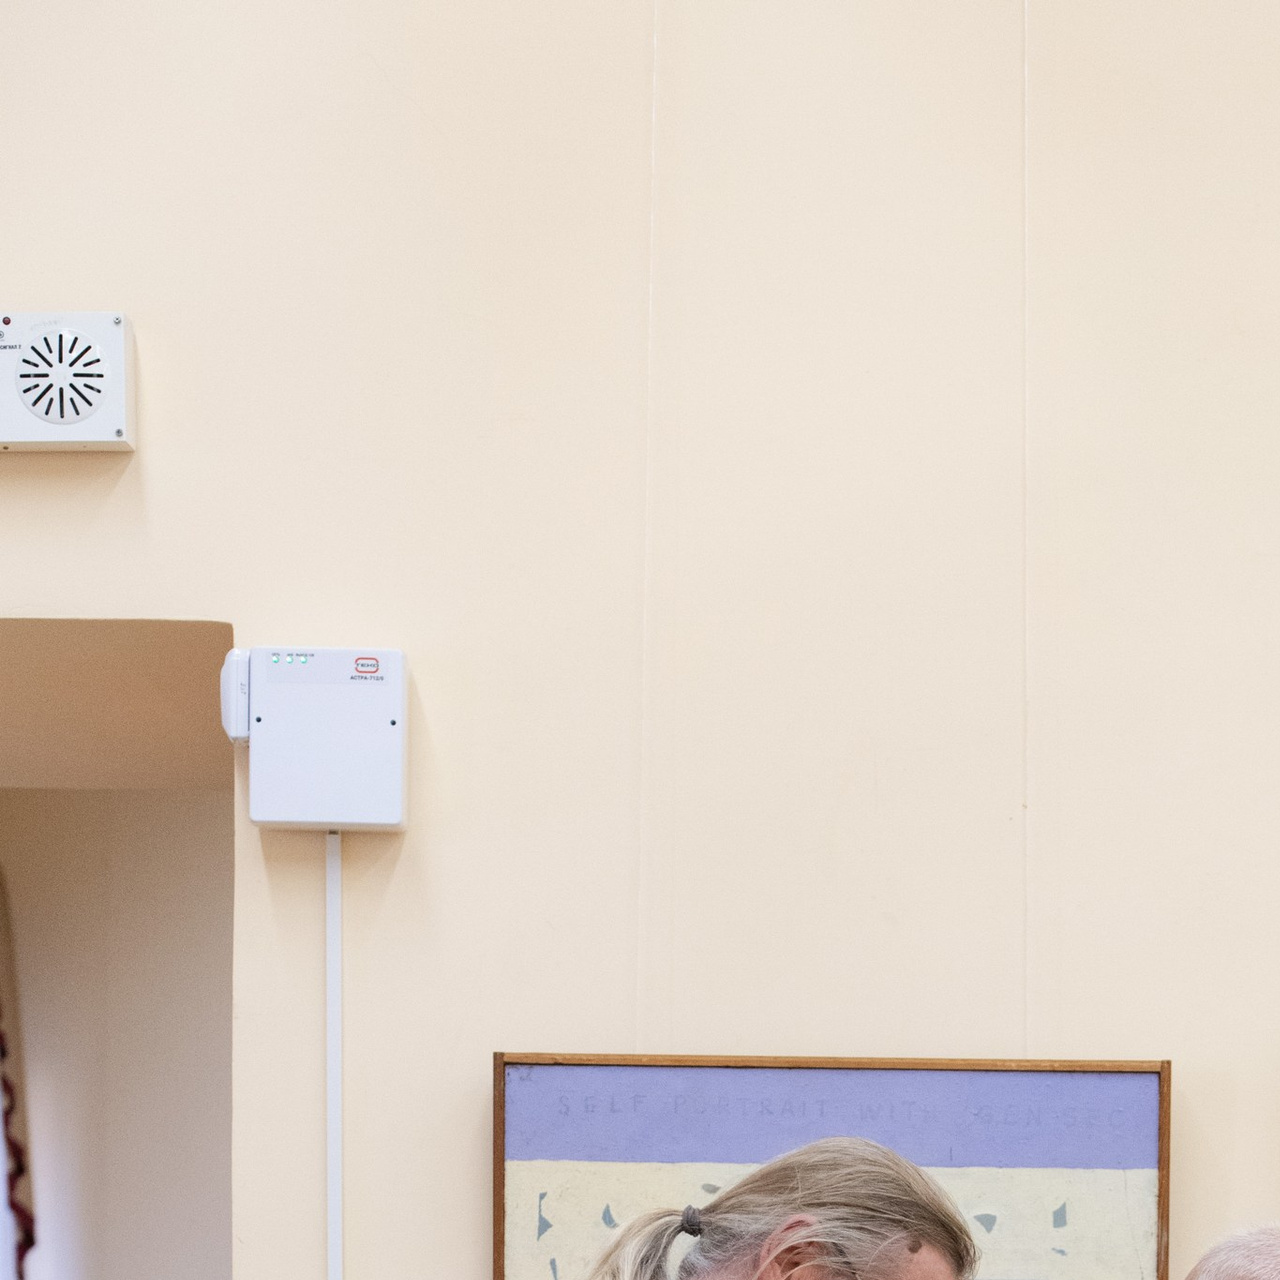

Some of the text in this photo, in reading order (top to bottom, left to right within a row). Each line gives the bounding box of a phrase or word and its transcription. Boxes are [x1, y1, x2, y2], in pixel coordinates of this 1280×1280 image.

[558, 1094, 647, 1117] SELF
[673, 1095, 830, 1119] PORTRAIT
[859, 1101, 938, 1124] WITH
